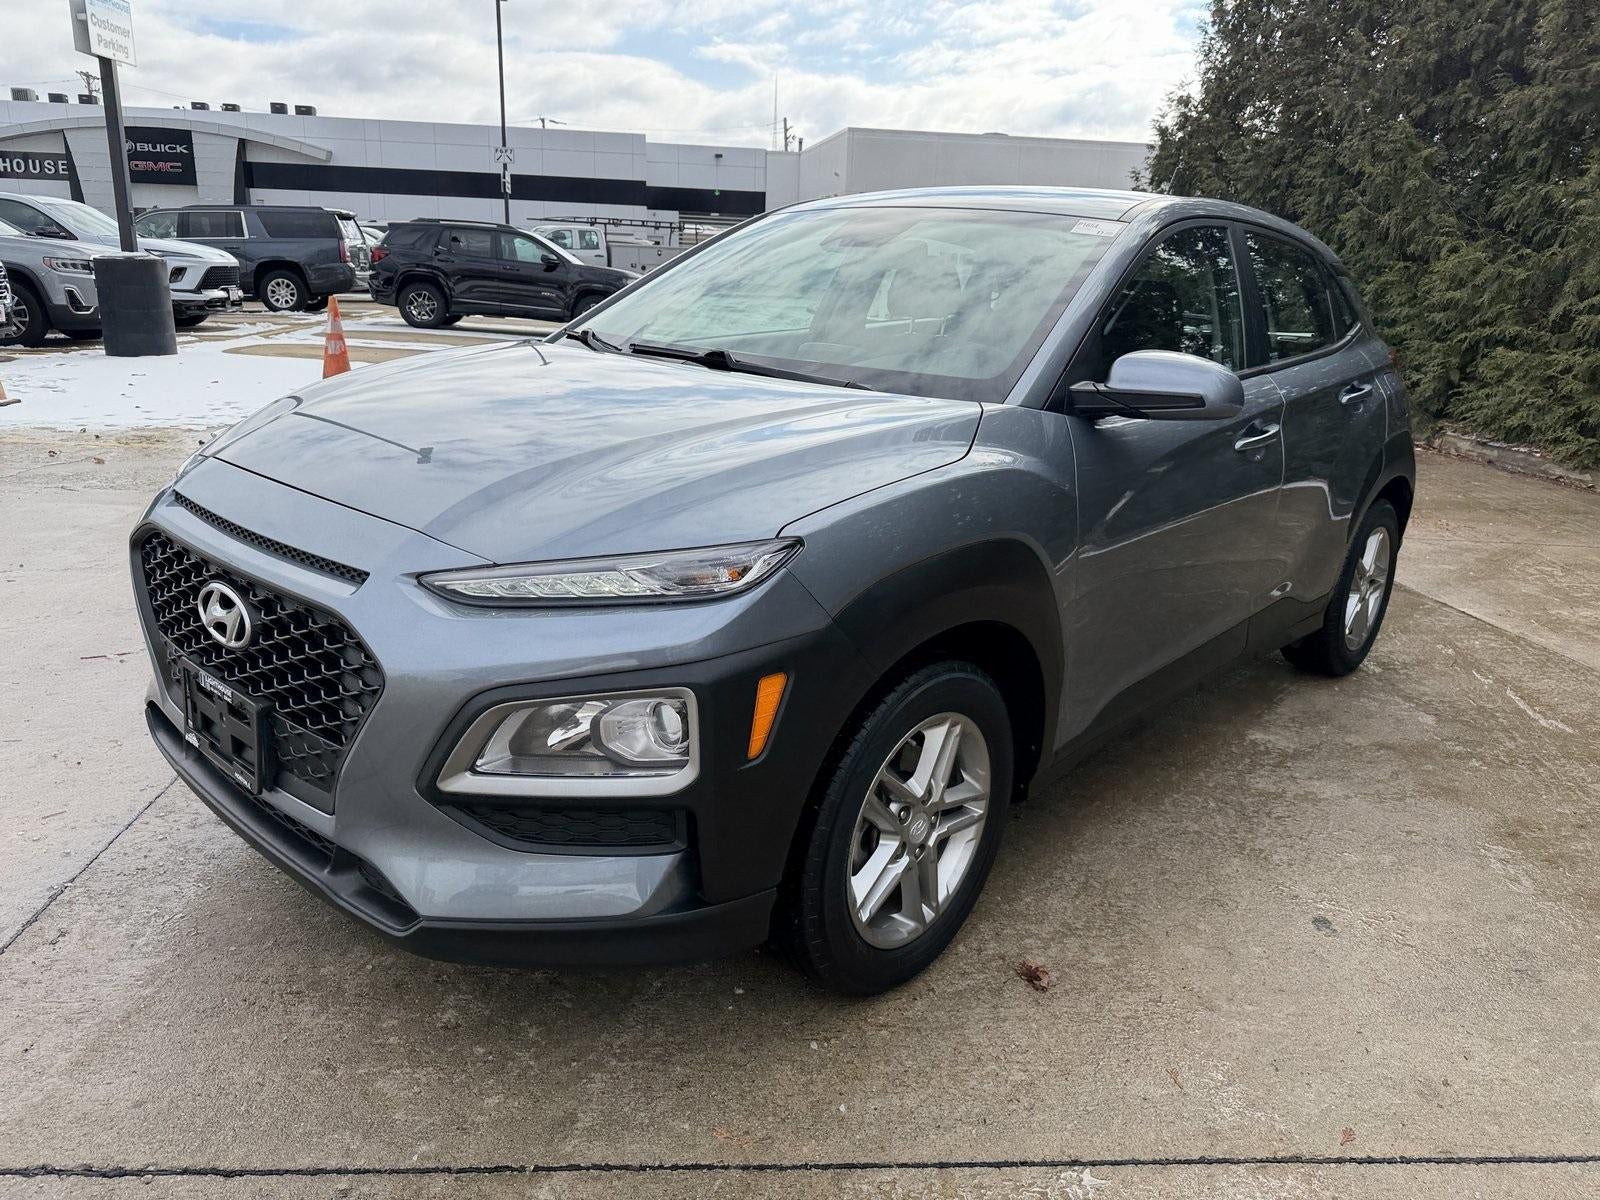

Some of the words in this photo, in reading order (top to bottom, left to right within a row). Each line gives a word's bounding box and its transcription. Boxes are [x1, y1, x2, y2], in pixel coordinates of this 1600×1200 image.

[90, 12, 130, 38] Customer
[97, 33, 129, 58] Parking
[136, 142, 190, 153] BUICK
[0, 158, 69, 175] HOUSE
[130, 160, 183, 173] GMC
